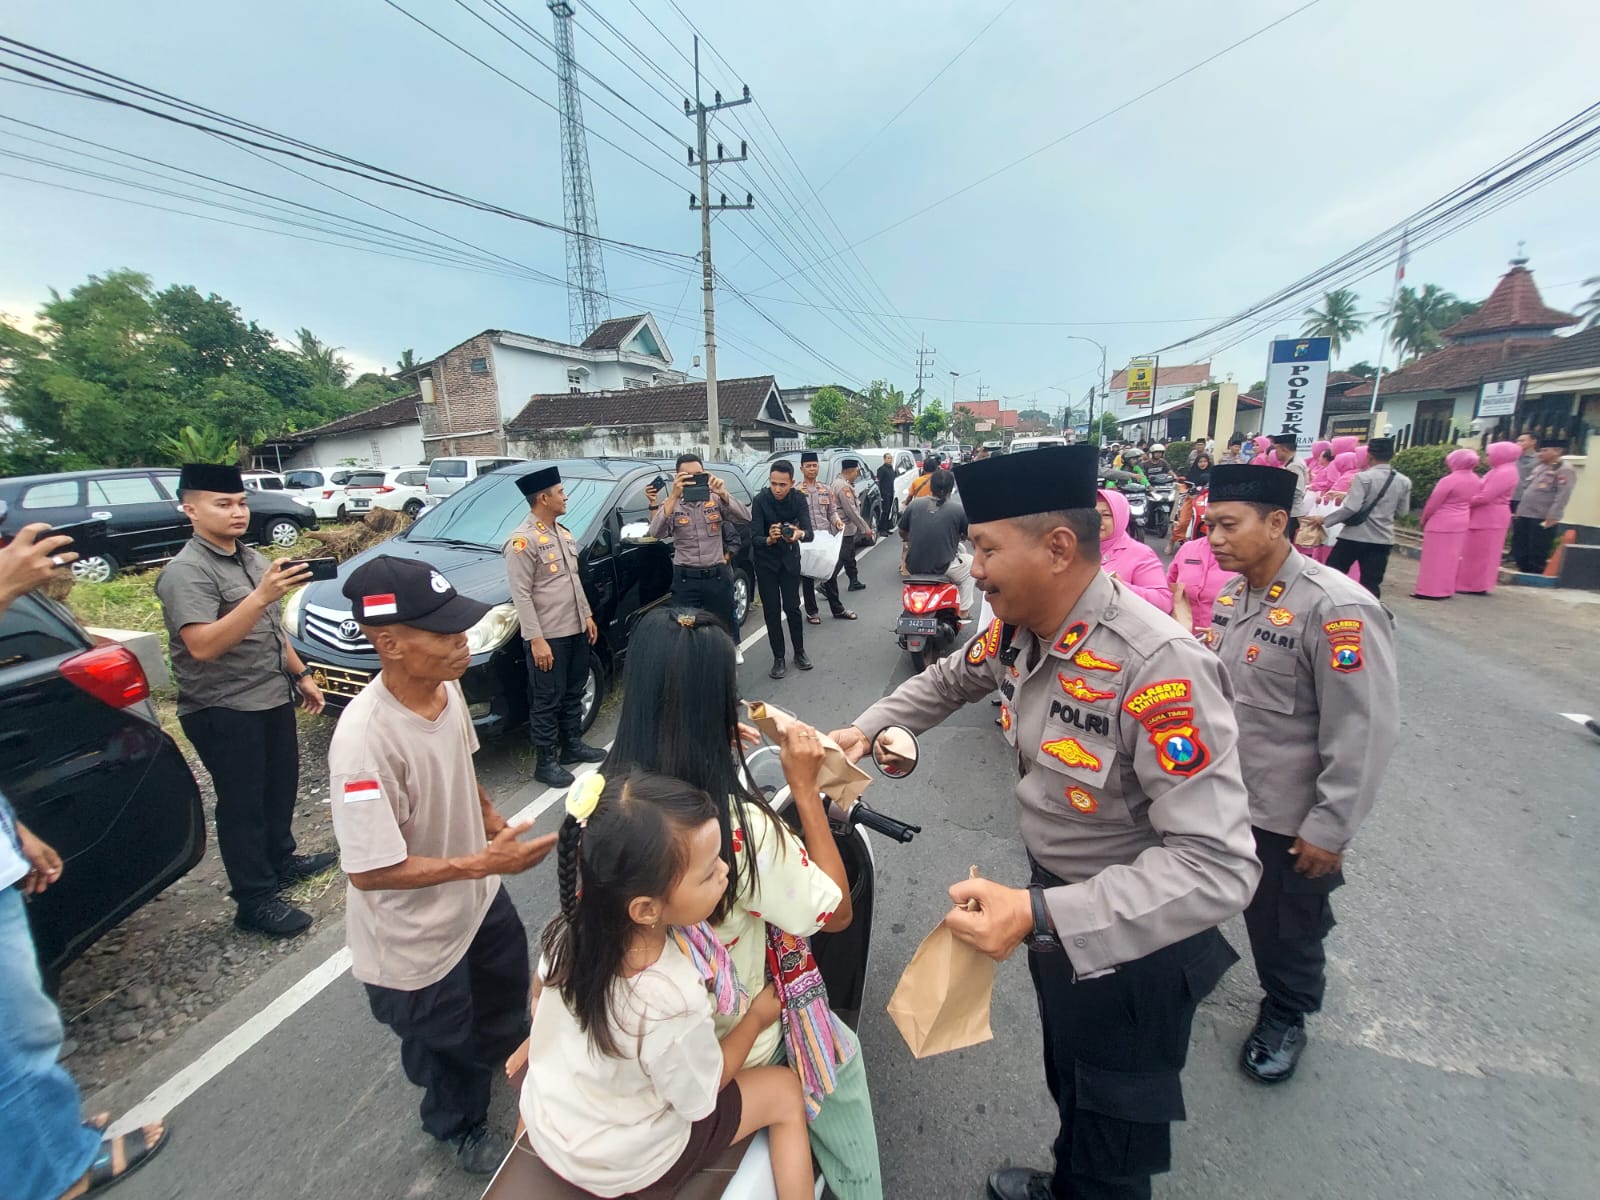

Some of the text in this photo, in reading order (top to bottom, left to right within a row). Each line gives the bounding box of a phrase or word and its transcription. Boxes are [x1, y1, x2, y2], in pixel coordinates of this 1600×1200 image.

[1281, 365, 1310, 434] POLSEK
[1254, 628, 1295, 649] POLRI
[1127, 682, 1187, 710] POLRESTA
[1135, 689, 1185, 713] BANYUWANGI
[1049, 699, 1110, 736] POLRI
